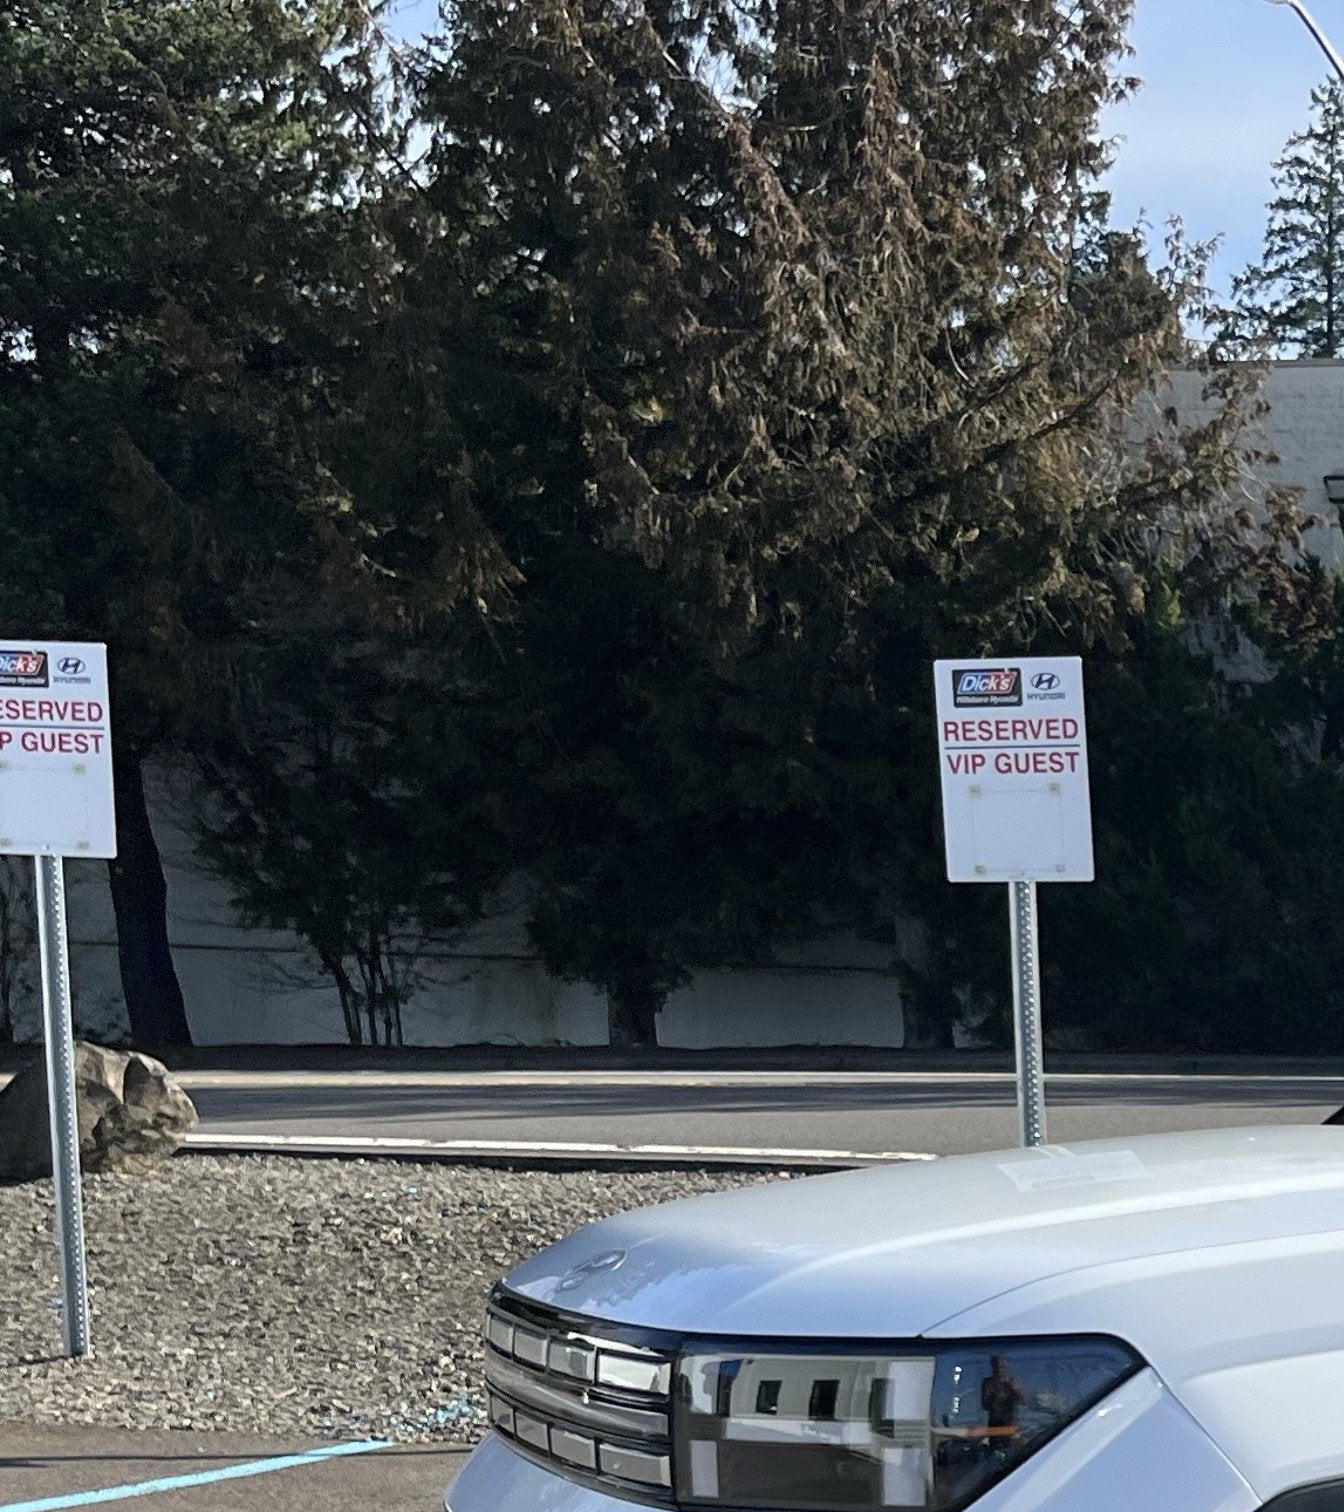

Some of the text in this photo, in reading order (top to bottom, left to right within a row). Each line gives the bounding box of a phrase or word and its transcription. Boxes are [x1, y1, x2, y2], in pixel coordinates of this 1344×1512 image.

[943, 718, 1079, 742] RESERVED
[21, 731, 104, 754] GUEST
[947, 751, 1080, 774] VIP GUEST
